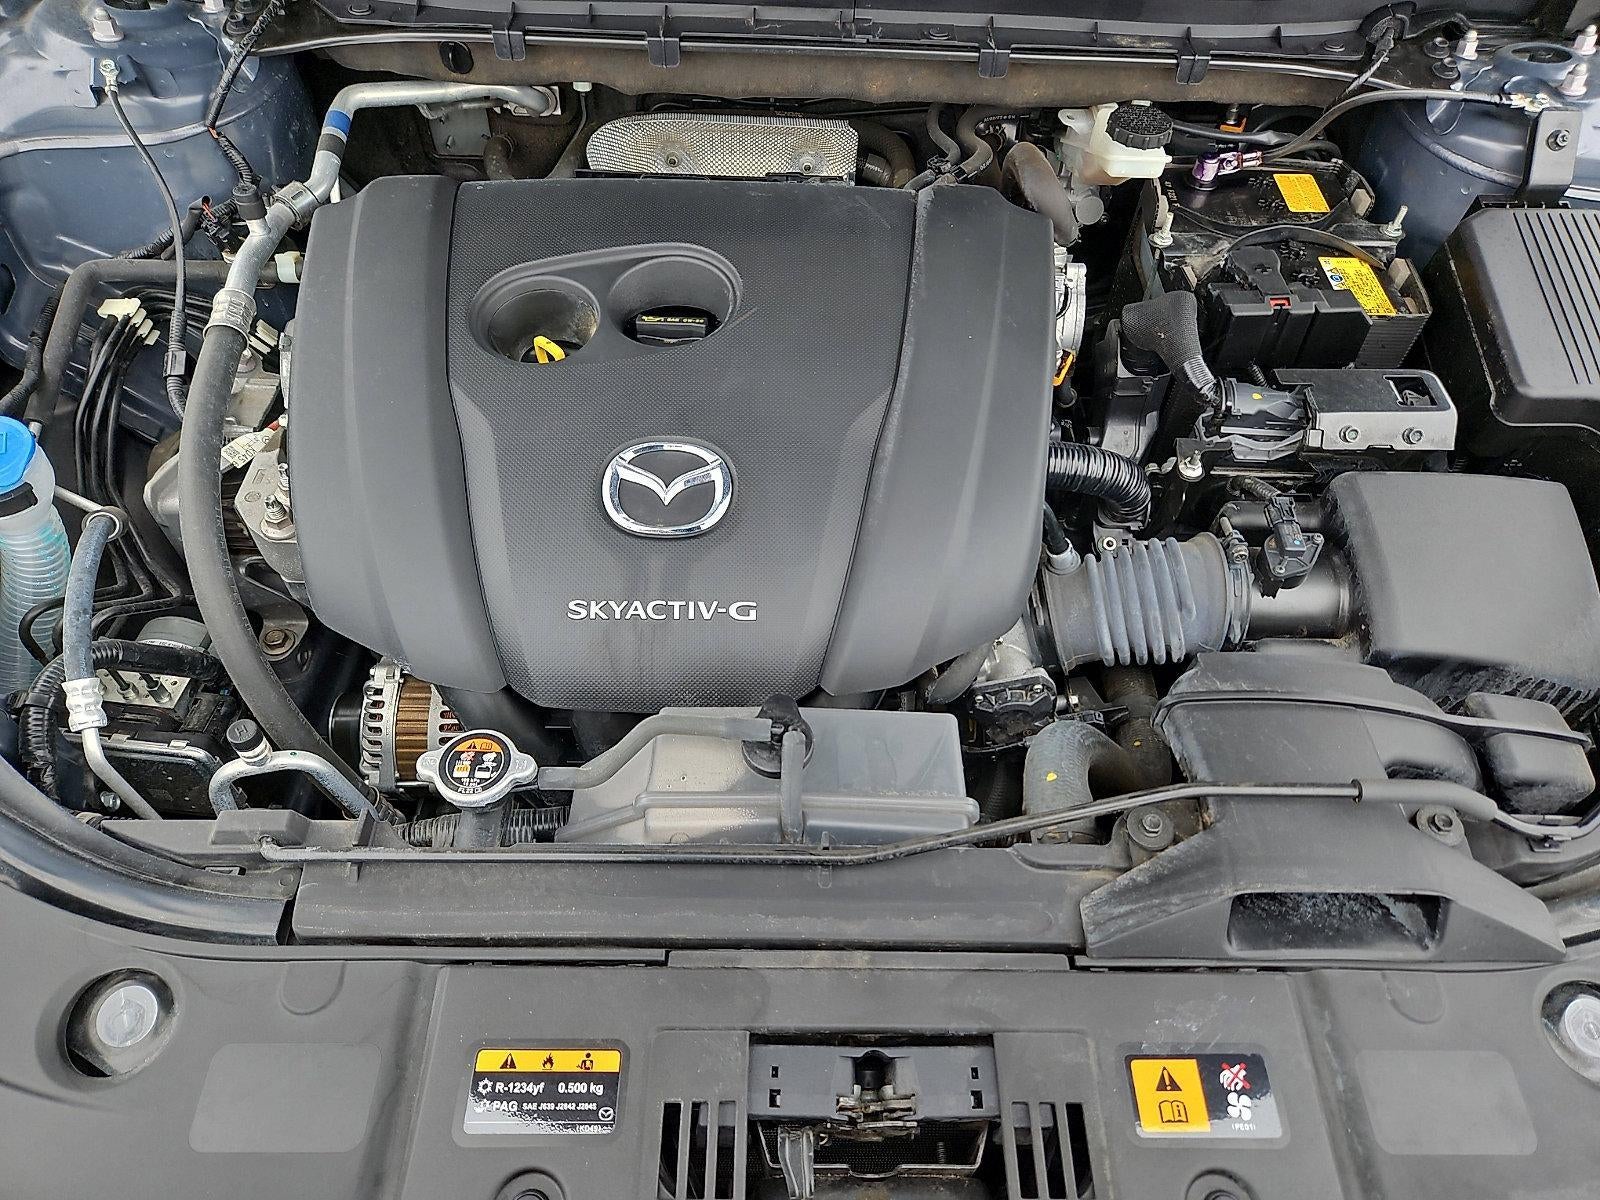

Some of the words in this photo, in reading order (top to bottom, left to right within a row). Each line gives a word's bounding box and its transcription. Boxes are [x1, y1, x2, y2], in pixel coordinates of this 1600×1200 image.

[566, 599, 759, 622] SKYACTIV-G
[494, 1081, 546, 1096] R-1234yf
[557, 1082, 588, 1094] 0.500
[589, 1081, 605, 1096] kg
[492, 1100, 519, 1112] PAG
